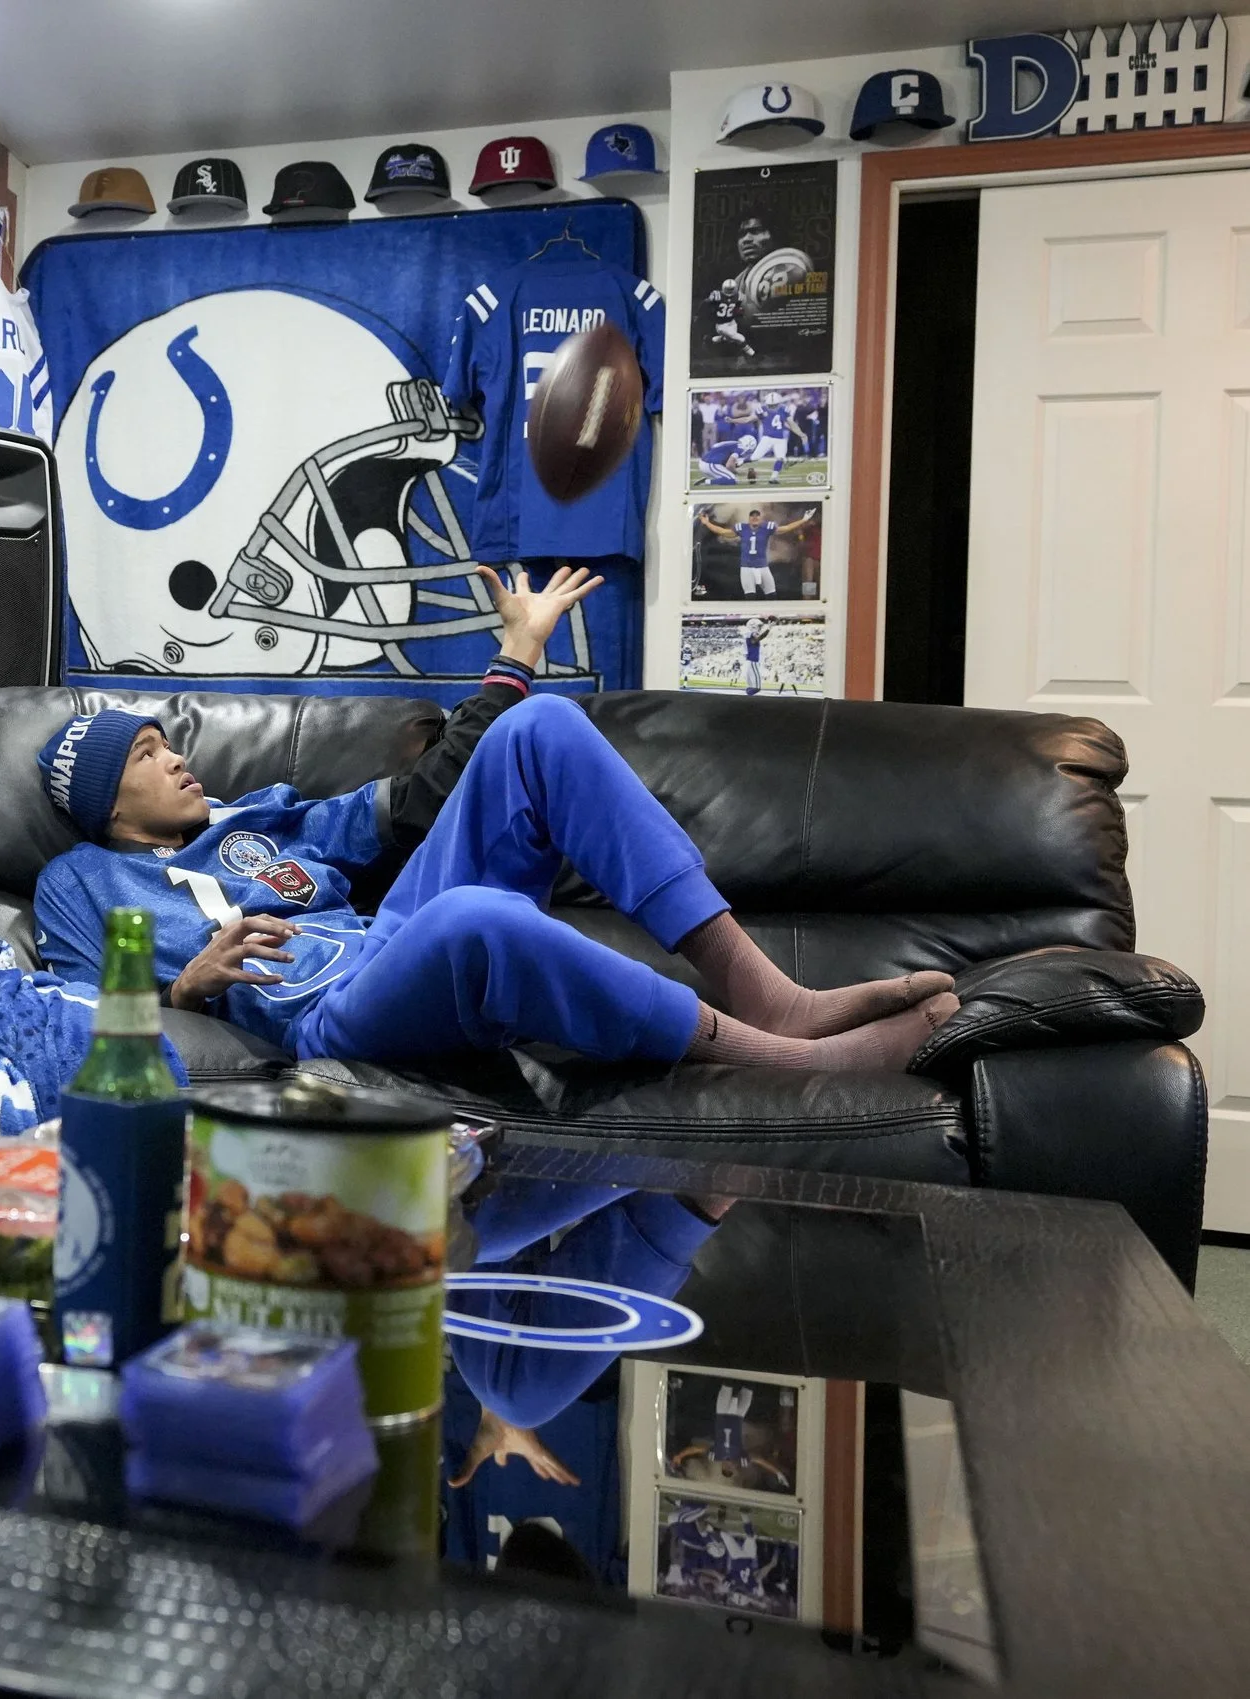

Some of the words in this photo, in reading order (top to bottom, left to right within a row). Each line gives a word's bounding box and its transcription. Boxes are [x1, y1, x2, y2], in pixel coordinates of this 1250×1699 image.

[1129, 52, 1157, 70] COLTS
[967, 33, 1083, 142] D
[522, 308, 606, 334] LEONARD
[771, 414, 783, 430] 4
[749, 536, 758, 555] 1
[283, 884, 313, 898] BULLYING
[166, 865, 244, 942] 1
